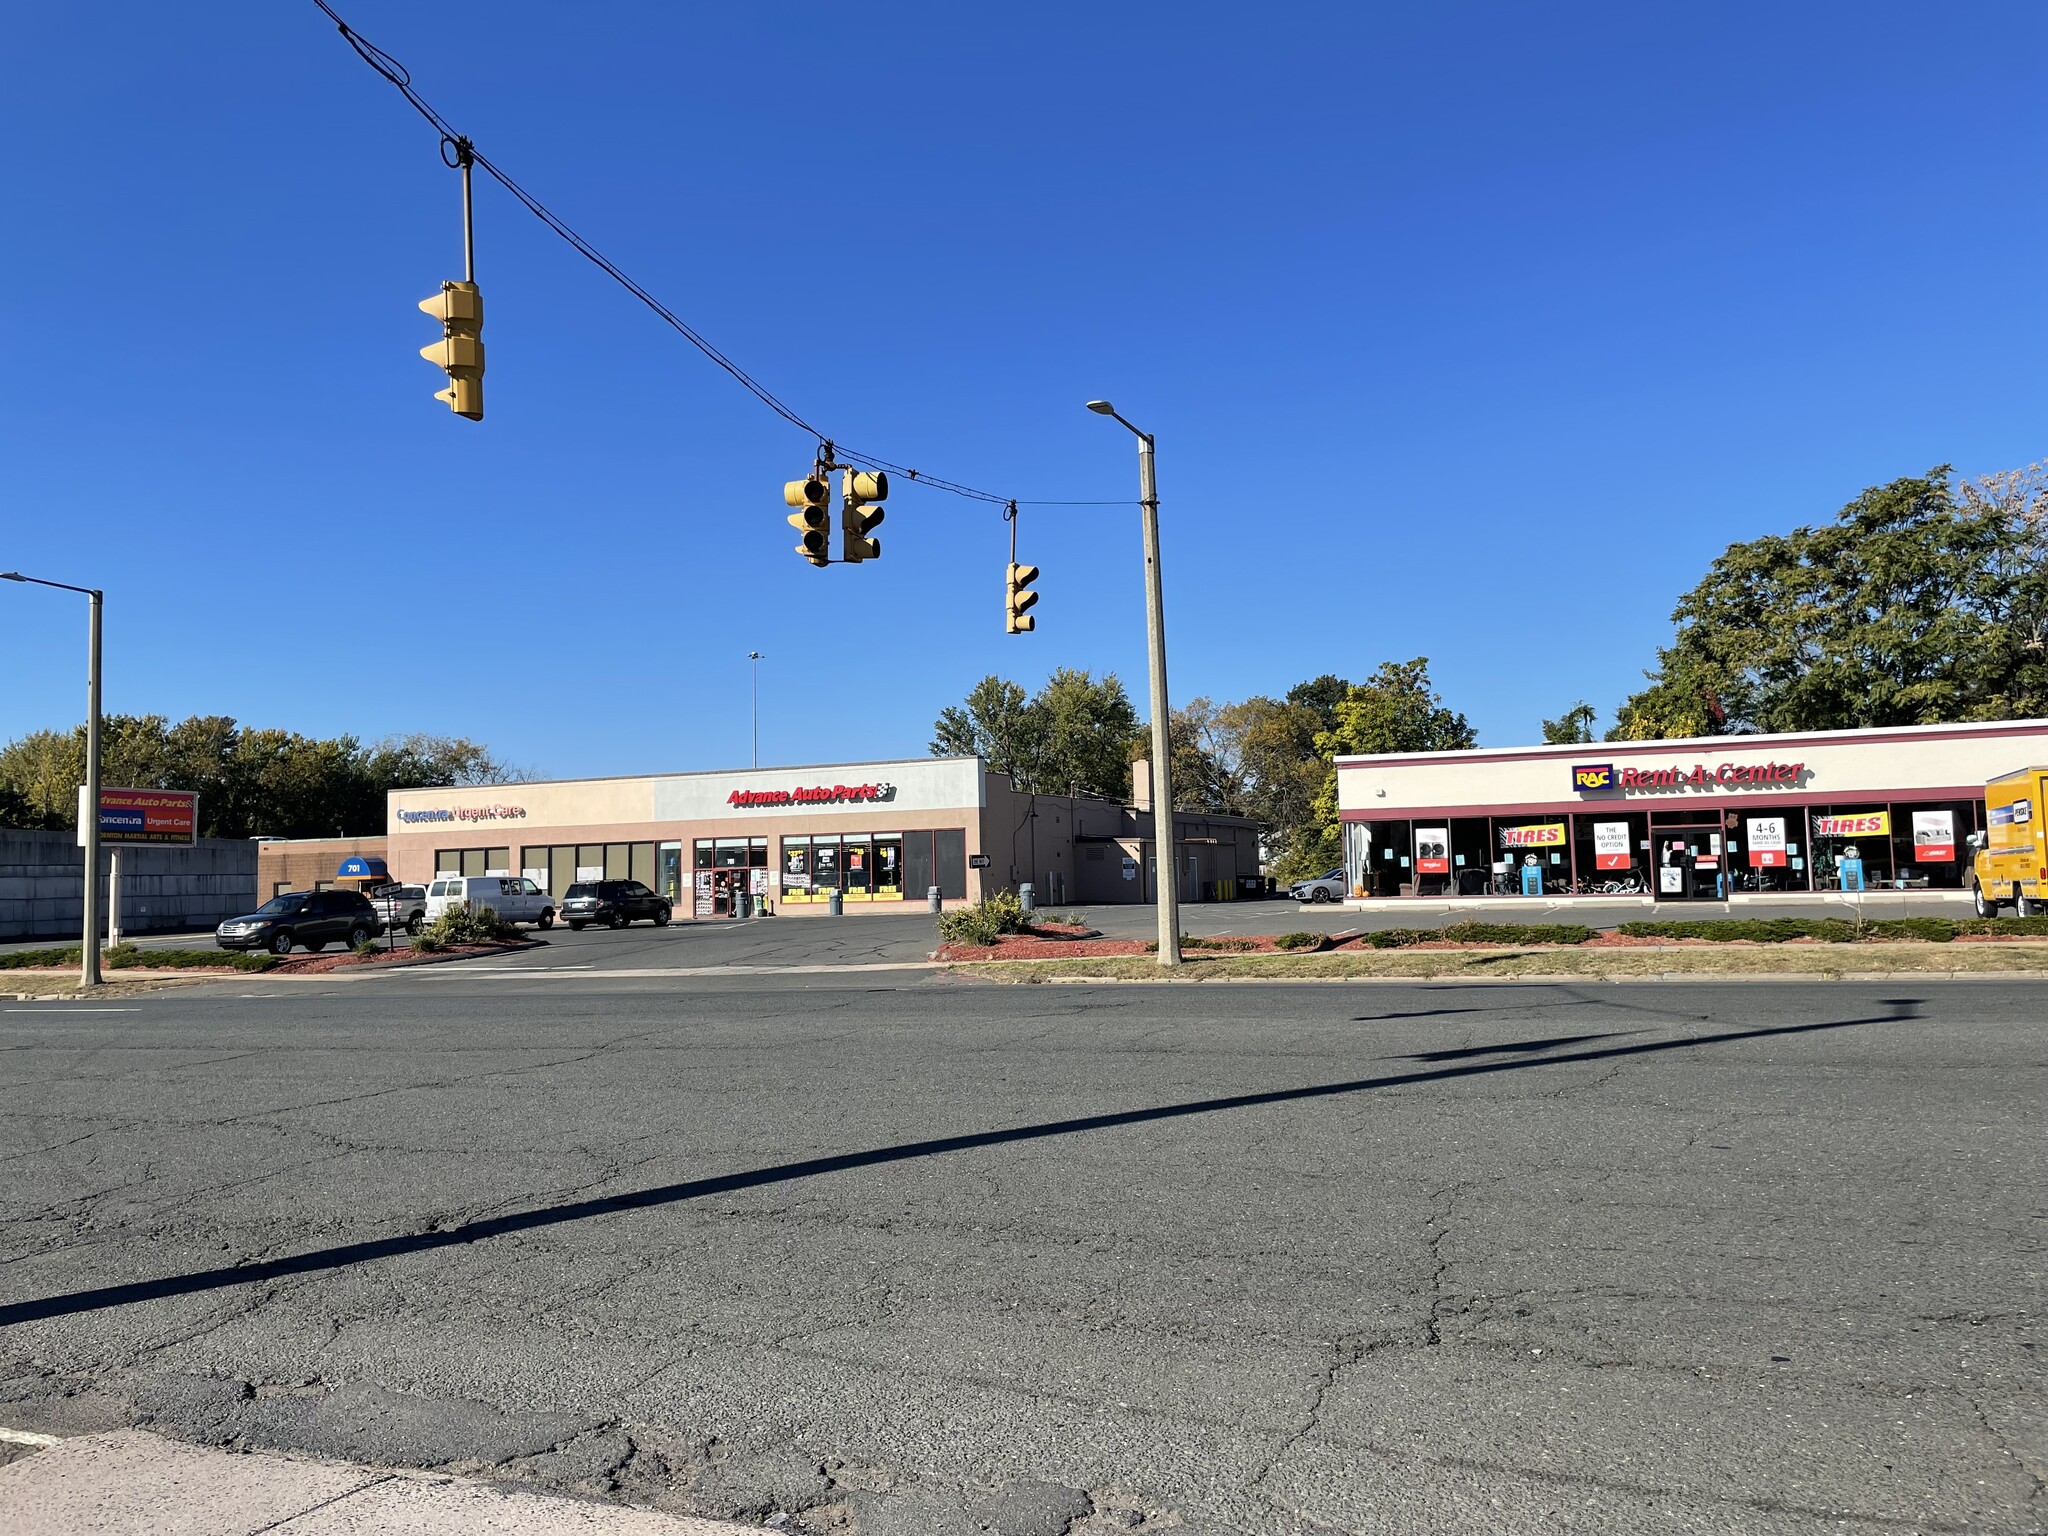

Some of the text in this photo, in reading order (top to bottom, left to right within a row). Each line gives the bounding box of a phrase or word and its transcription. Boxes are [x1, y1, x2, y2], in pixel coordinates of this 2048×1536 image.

[1576, 772, 1610, 788] RAC
[100, 795, 133, 805] dvance
[133, 797, 159, 806] Auto
[726, 789, 788, 804] Advance
[790, 786, 832, 801] Auto
[396, 803, 520, 820] Concentra Urgent Care
[147, 817, 172, 827] Urgent
[1756, 822, 1776, 834] 4-6
[1819, 816, 1881, 834] TIRES
[1505, 828, 1559, 844] TIRES
[347, 864, 361, 872] 701
[788, 888, 805, 896] FREE
[879, 885, 897, 893] FREE
